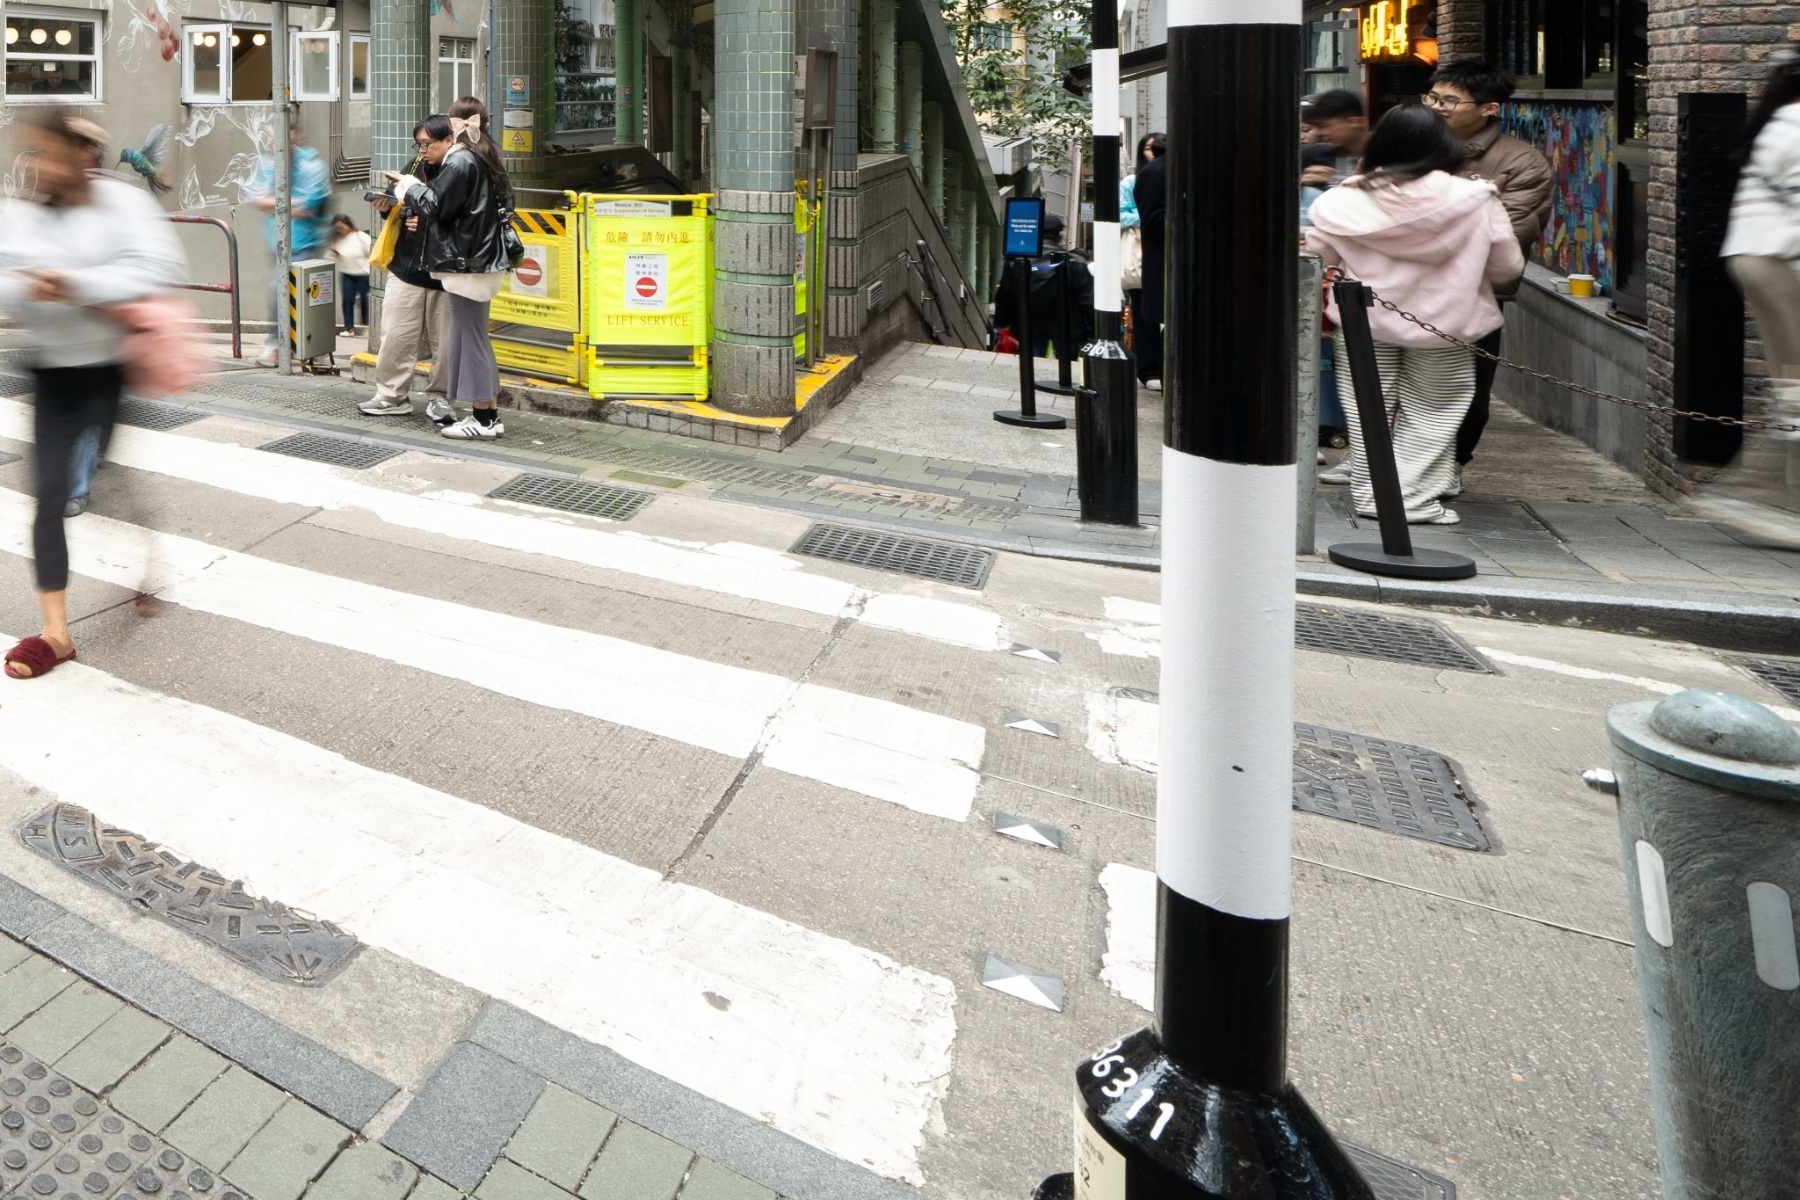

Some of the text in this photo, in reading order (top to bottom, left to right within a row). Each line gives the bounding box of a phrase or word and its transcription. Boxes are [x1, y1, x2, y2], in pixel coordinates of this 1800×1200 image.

[606, 231, 691, 244] 危險 請勿內進
[607, 315, 689, 327] LIFT SERVICE
